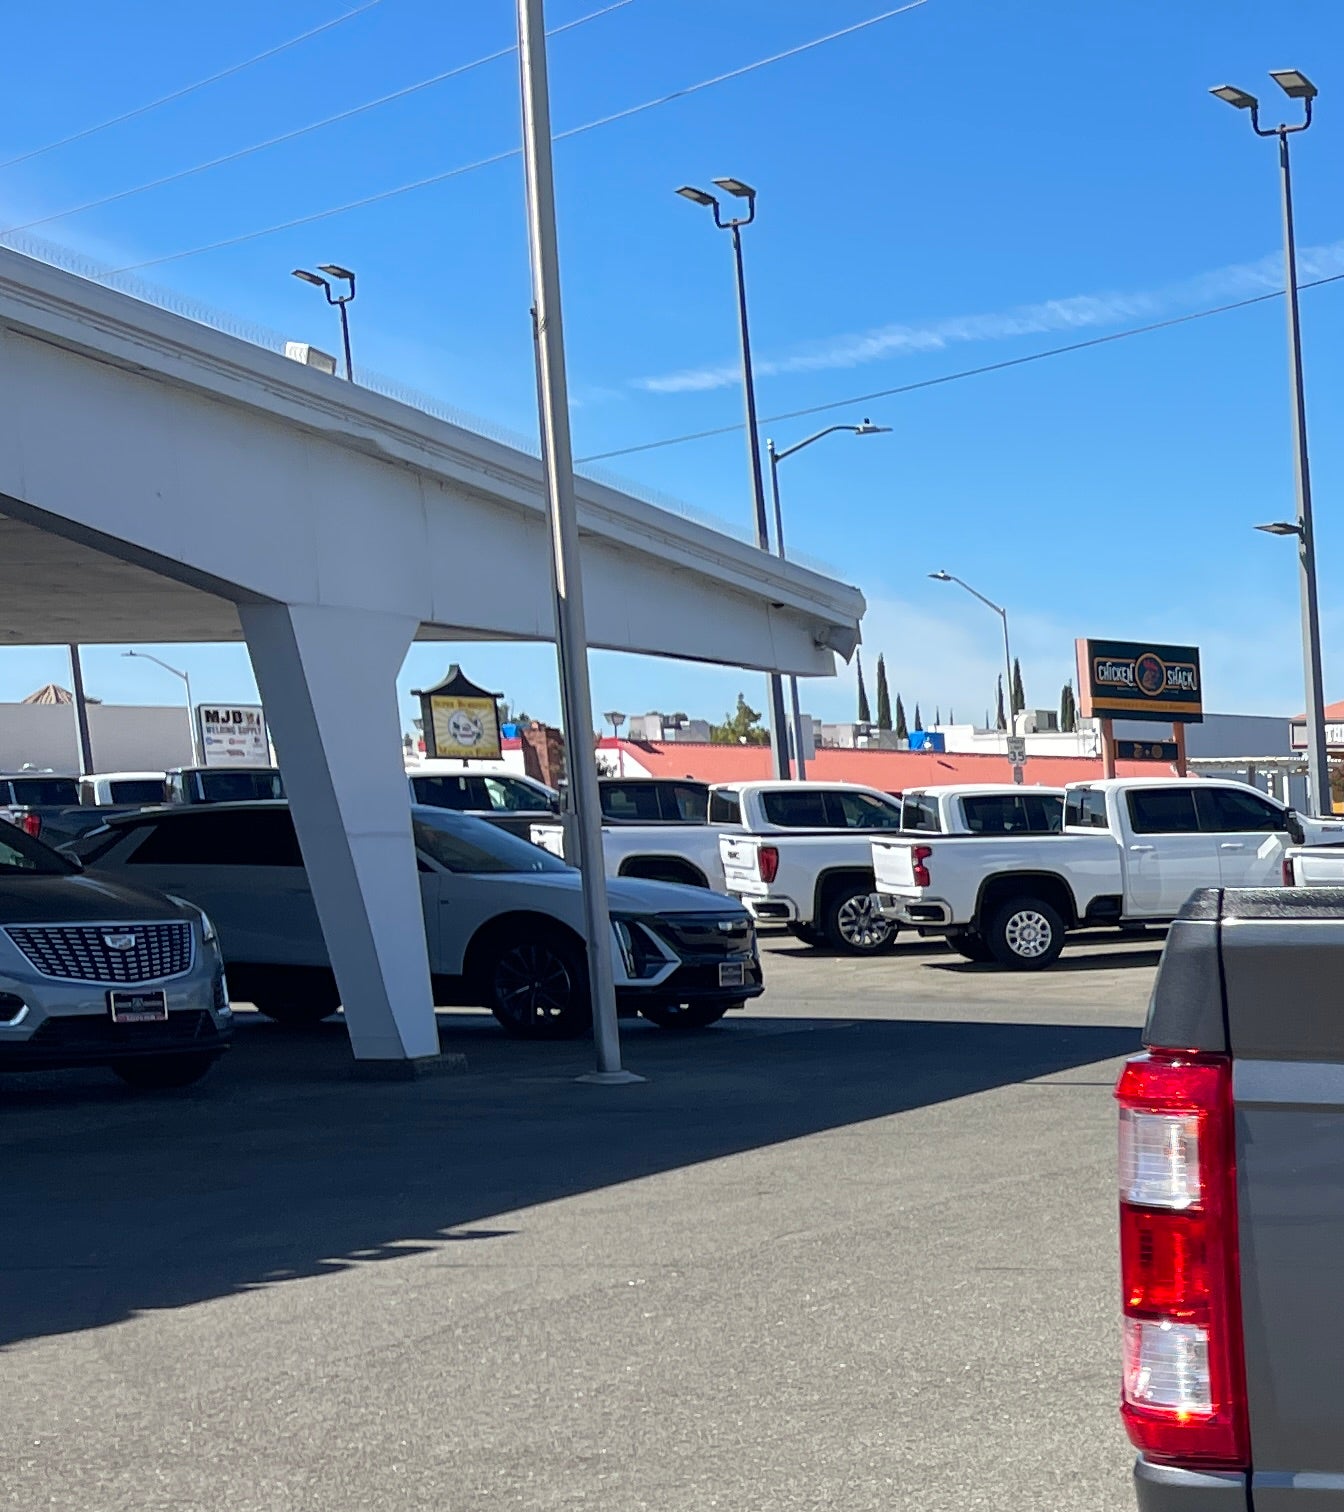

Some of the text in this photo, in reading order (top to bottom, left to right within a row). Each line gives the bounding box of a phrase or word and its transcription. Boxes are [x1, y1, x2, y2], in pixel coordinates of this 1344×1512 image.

[1098, 662, 1197, 691] CHICKEN SHACK
[1010, 751, 1025, 761] 35
